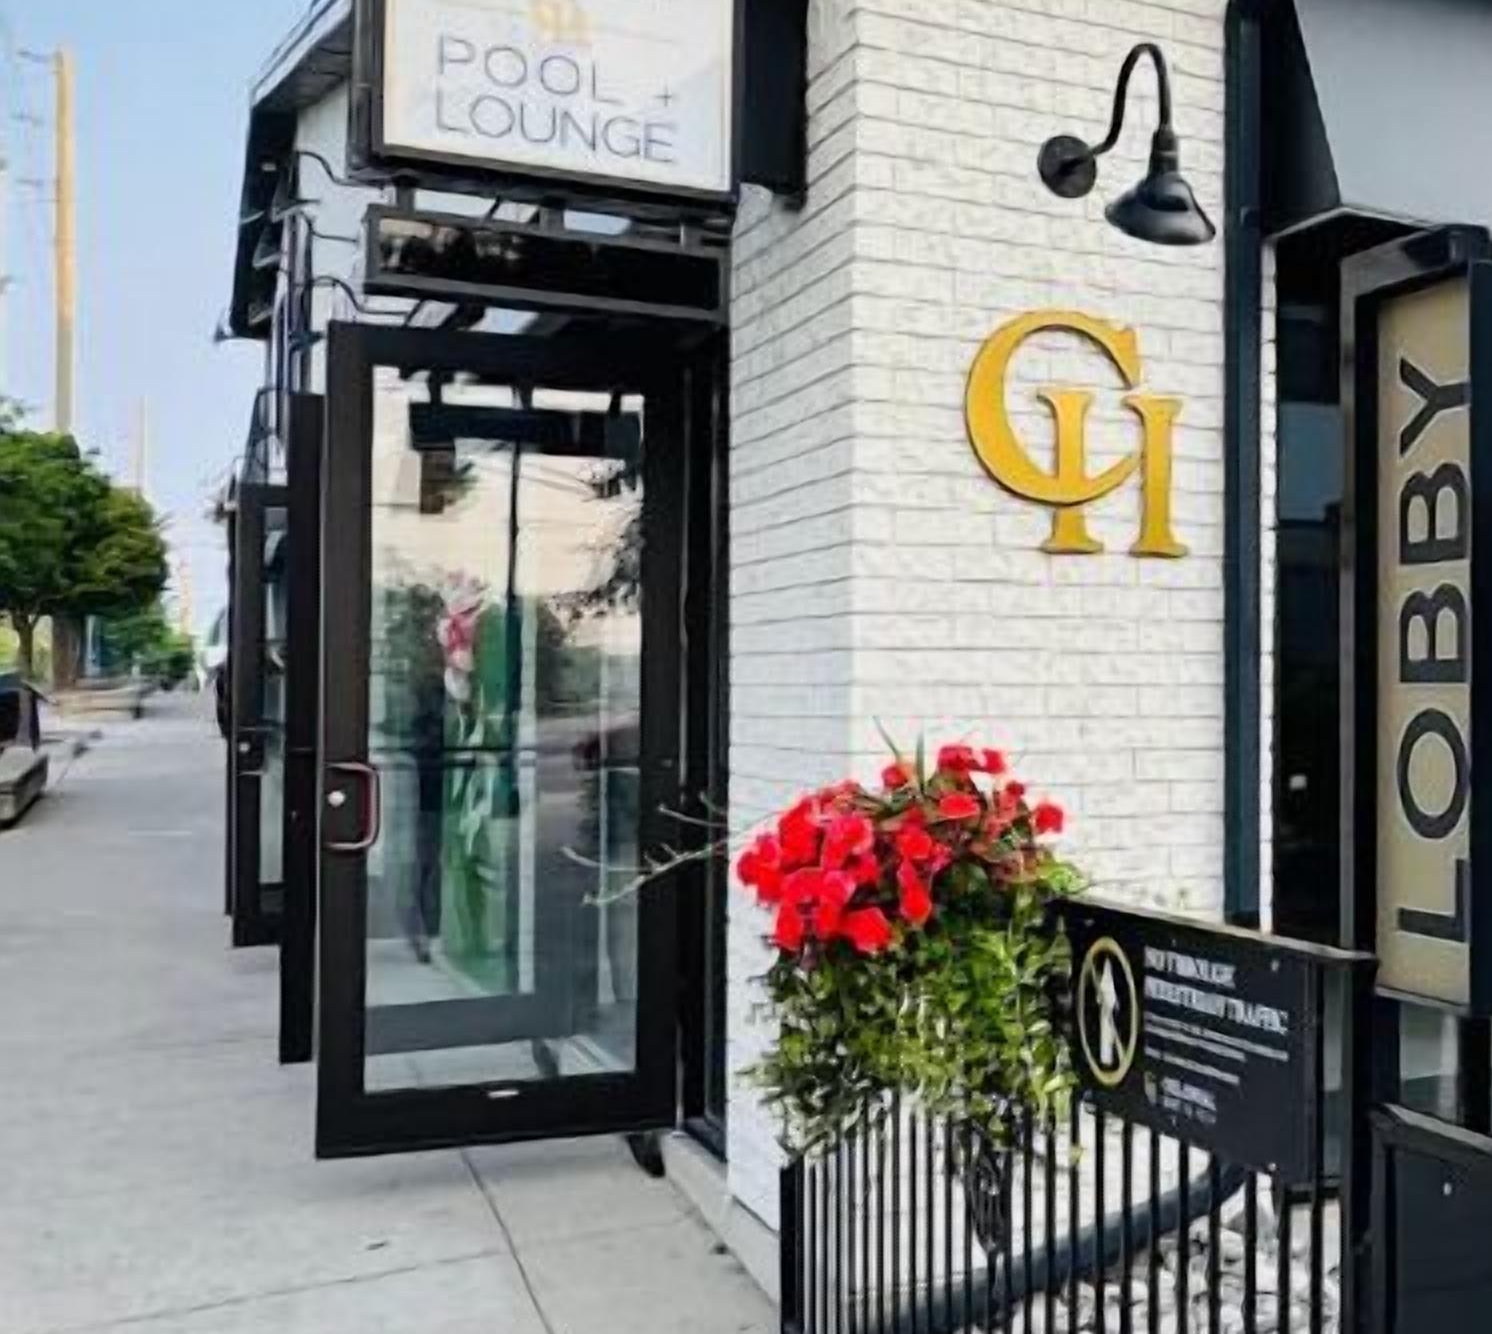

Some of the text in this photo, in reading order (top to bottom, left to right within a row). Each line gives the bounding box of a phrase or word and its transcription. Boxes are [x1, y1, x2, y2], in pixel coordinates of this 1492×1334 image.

[438, 32, 624, 106] POOL
[435, 89, 679, 165] LOUNGE
[1396, 356, 1471, 943] LOBBY
